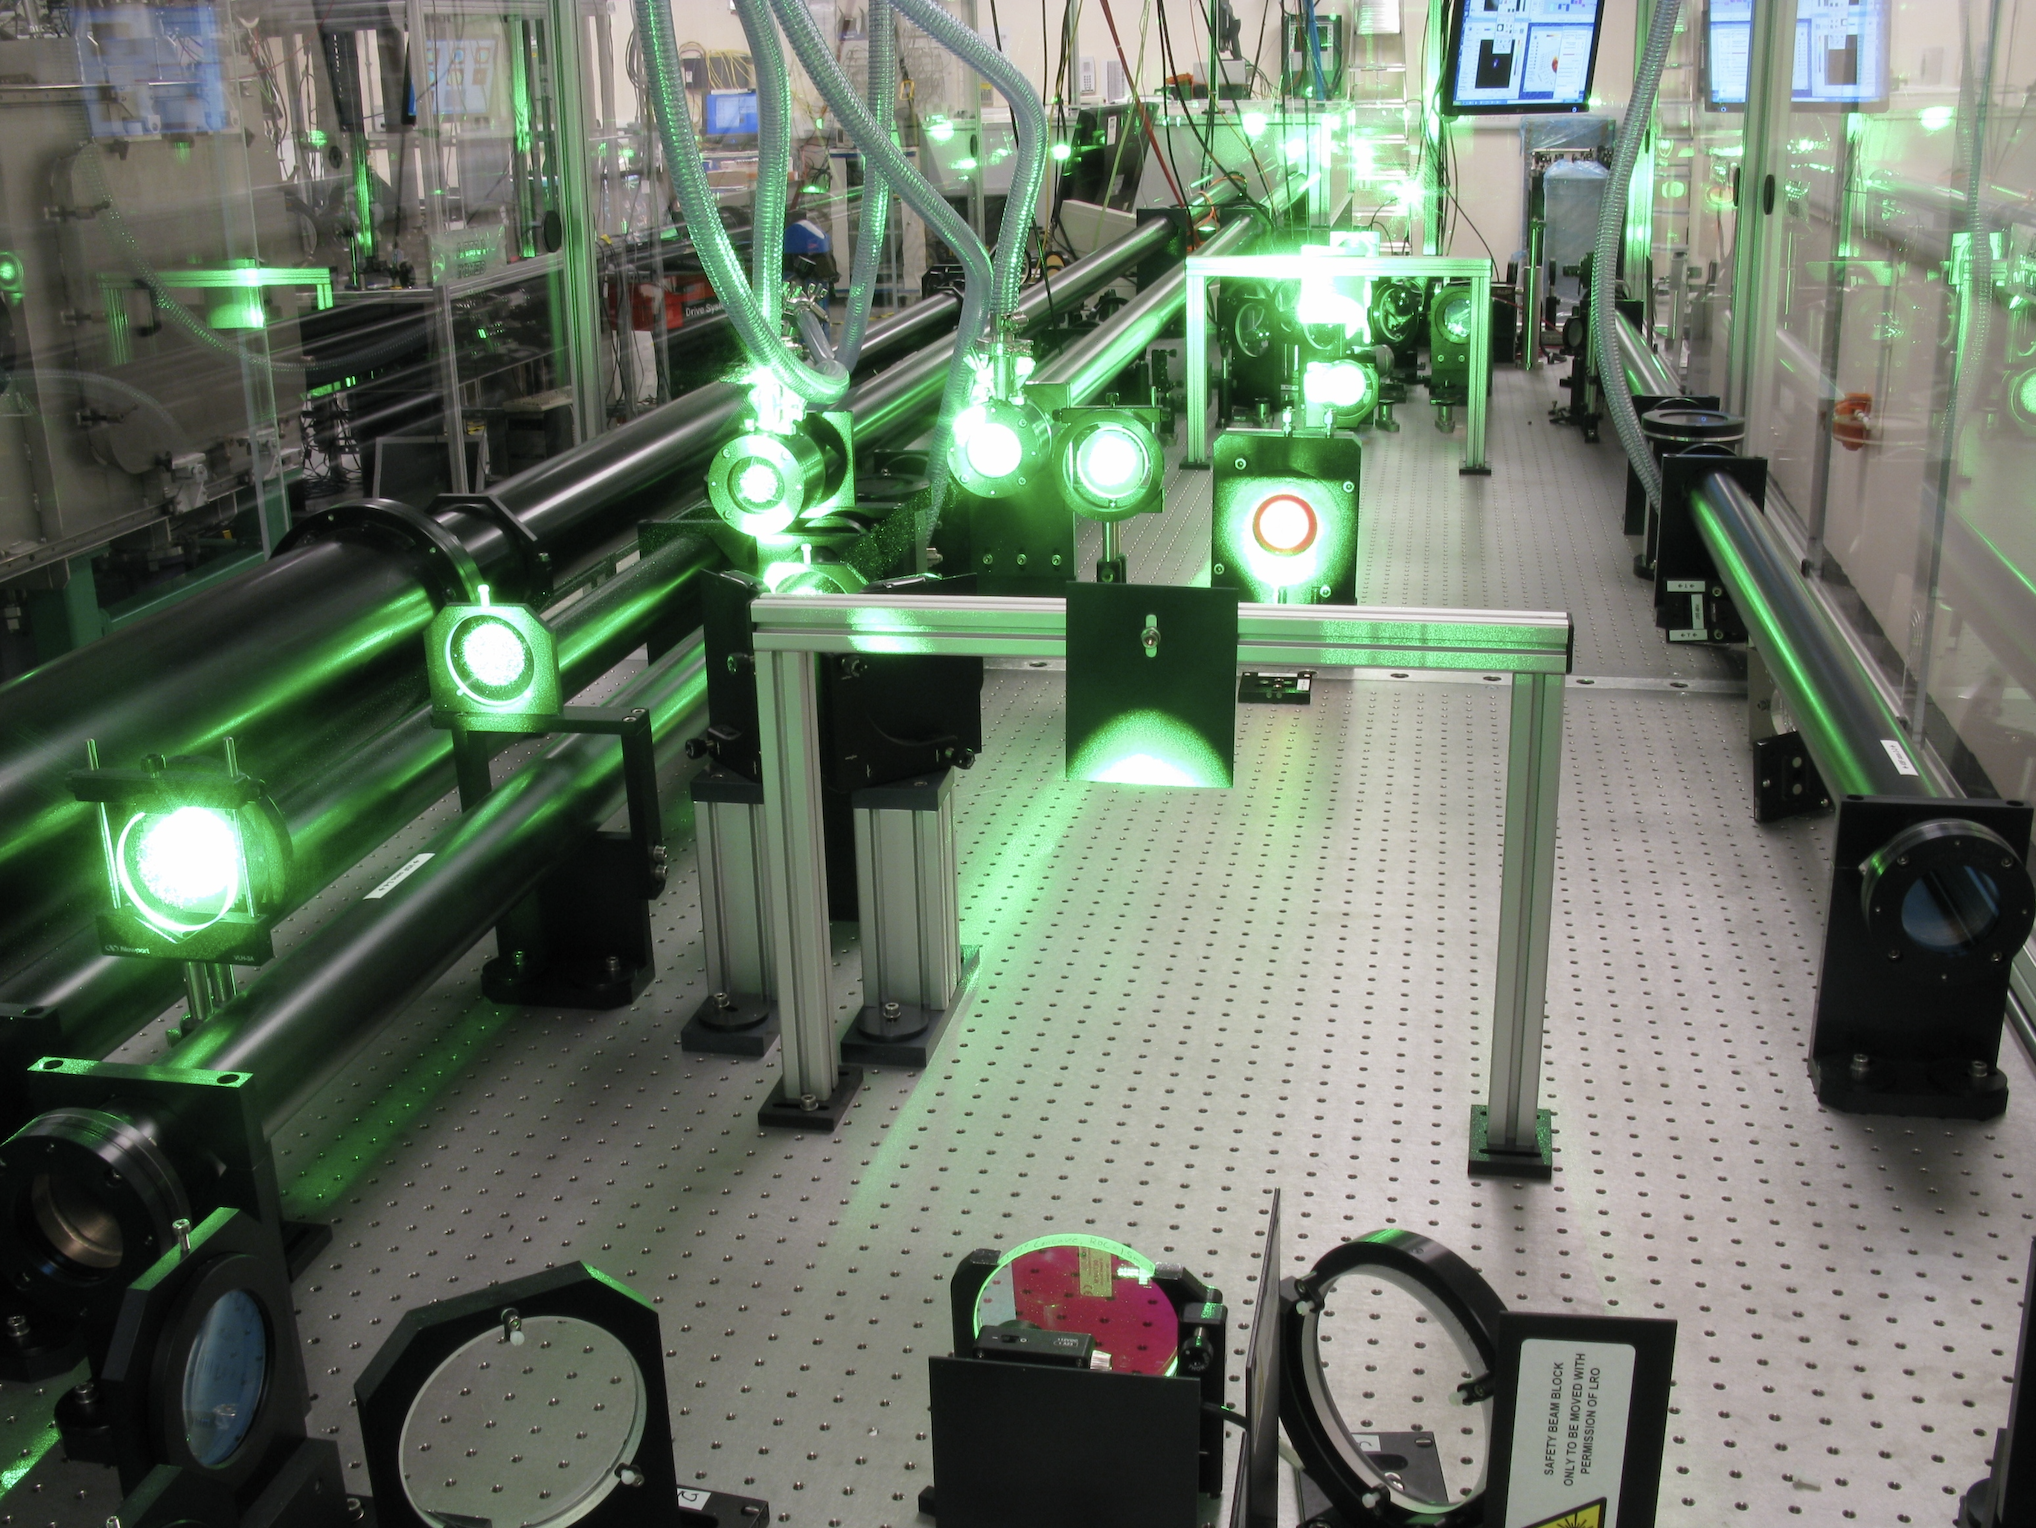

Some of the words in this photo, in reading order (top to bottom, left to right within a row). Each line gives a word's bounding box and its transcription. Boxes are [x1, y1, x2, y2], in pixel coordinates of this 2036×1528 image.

[685, 306, 705, 317] Drive
[1551, 1361, 1564, 1399] BLOCK
[1573, 1353, 1586, 1380] WITH
[1588, 1367, 1601, 1390] LRO
[1569, 1383, 1583, 1422] MOVED
[1586, 1392, 1598, 1408] OF
[1547, 1402, 1560, 1433] BEAM
[1567, 1424, 1579, 1439] BE
[1543, 1435, 1557, 1476] SAFETY
[1566, 1441, 1577, 1456] TO
[1580, 1410, 1596, 1475] PERMISSION
[1563, 1457, 1575, 1487] ONLY
